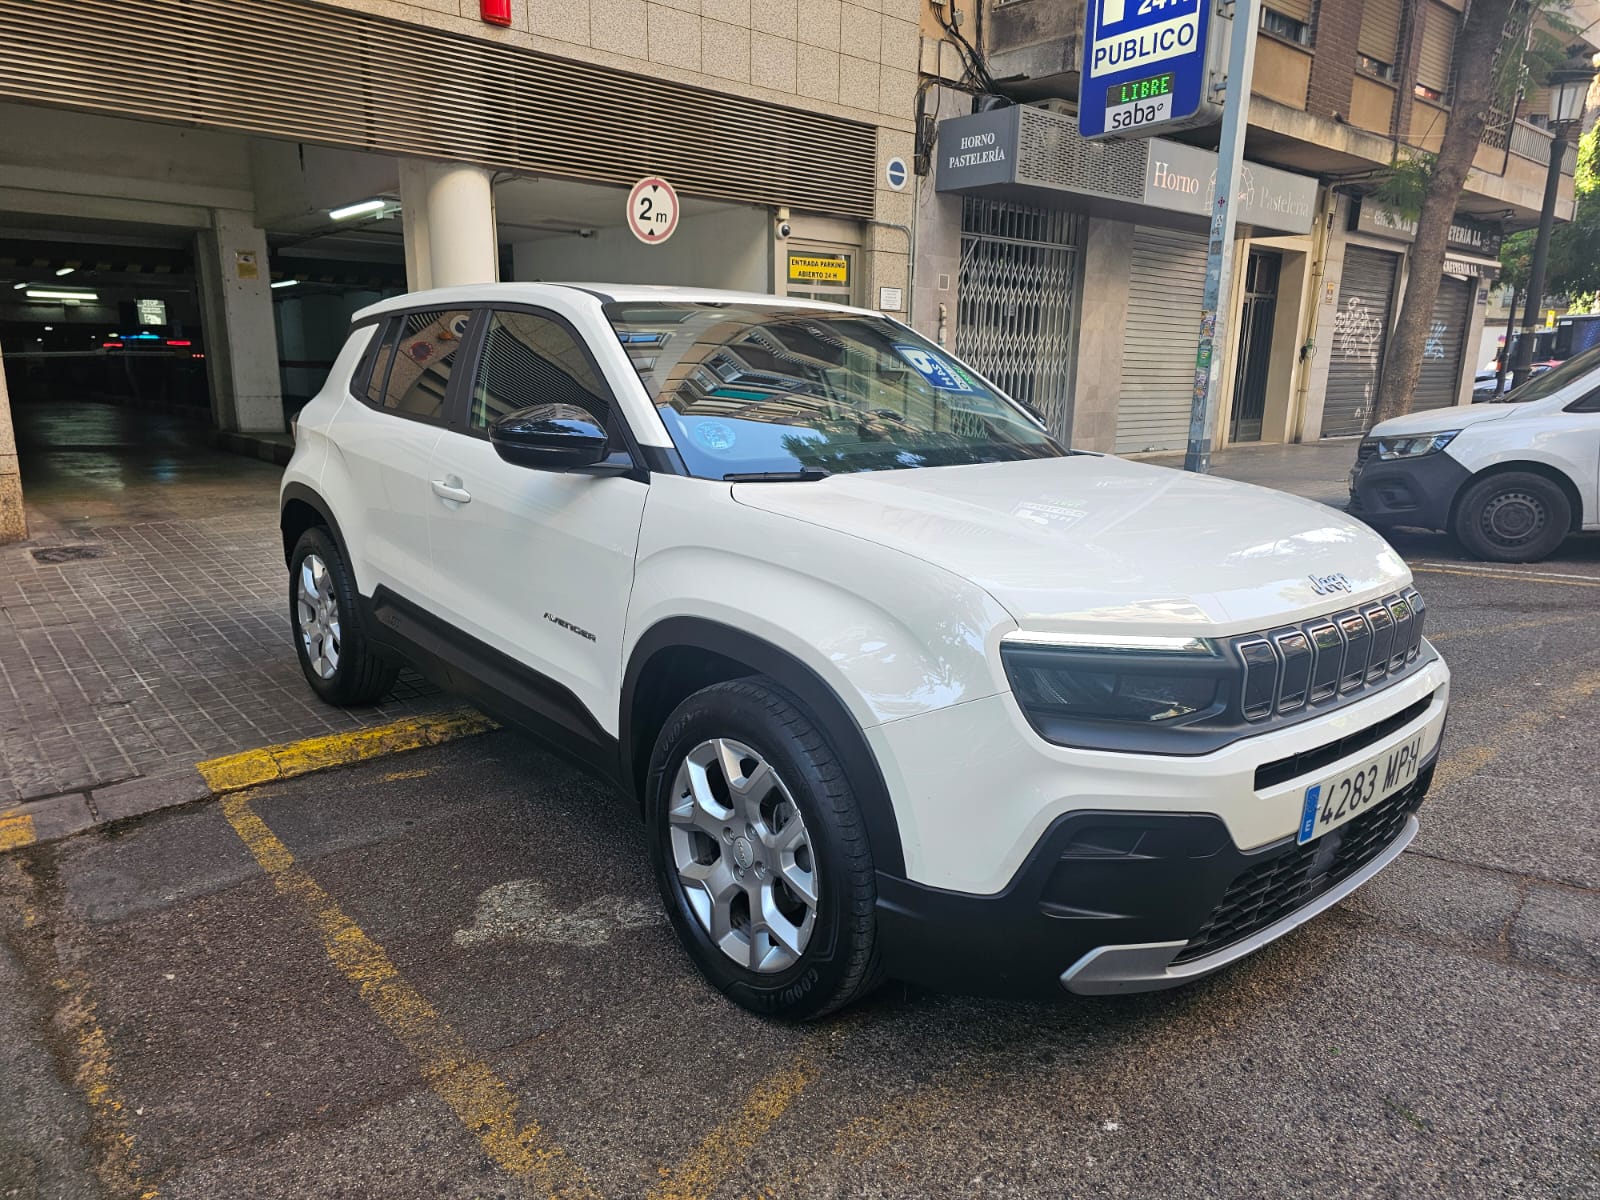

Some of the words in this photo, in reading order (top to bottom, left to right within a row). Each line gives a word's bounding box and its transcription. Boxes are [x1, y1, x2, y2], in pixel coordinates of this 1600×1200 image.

[1094, 23, 1194, 69] PUBLICO
[1121, 76, 1170, 102] LIBRE
[960, 132, 995, 149] HORNO
[949, 146, 1006, 169] PASTELERÍA
[1153, 161, 1199, 194] Horno
[639, 197, 653, 221] 2
[656, 212, 667, 223] m
[791, 258, 819, 267] ENTRADA
[820, 261, 846, 269] PARKING
[798, 270, 824, 278] ABIERTO
[1308, 573, 1352, 596] Jeep
[1320, 764, 1378, 825] 4283
[1382, 736, 1421, 793] MPH
